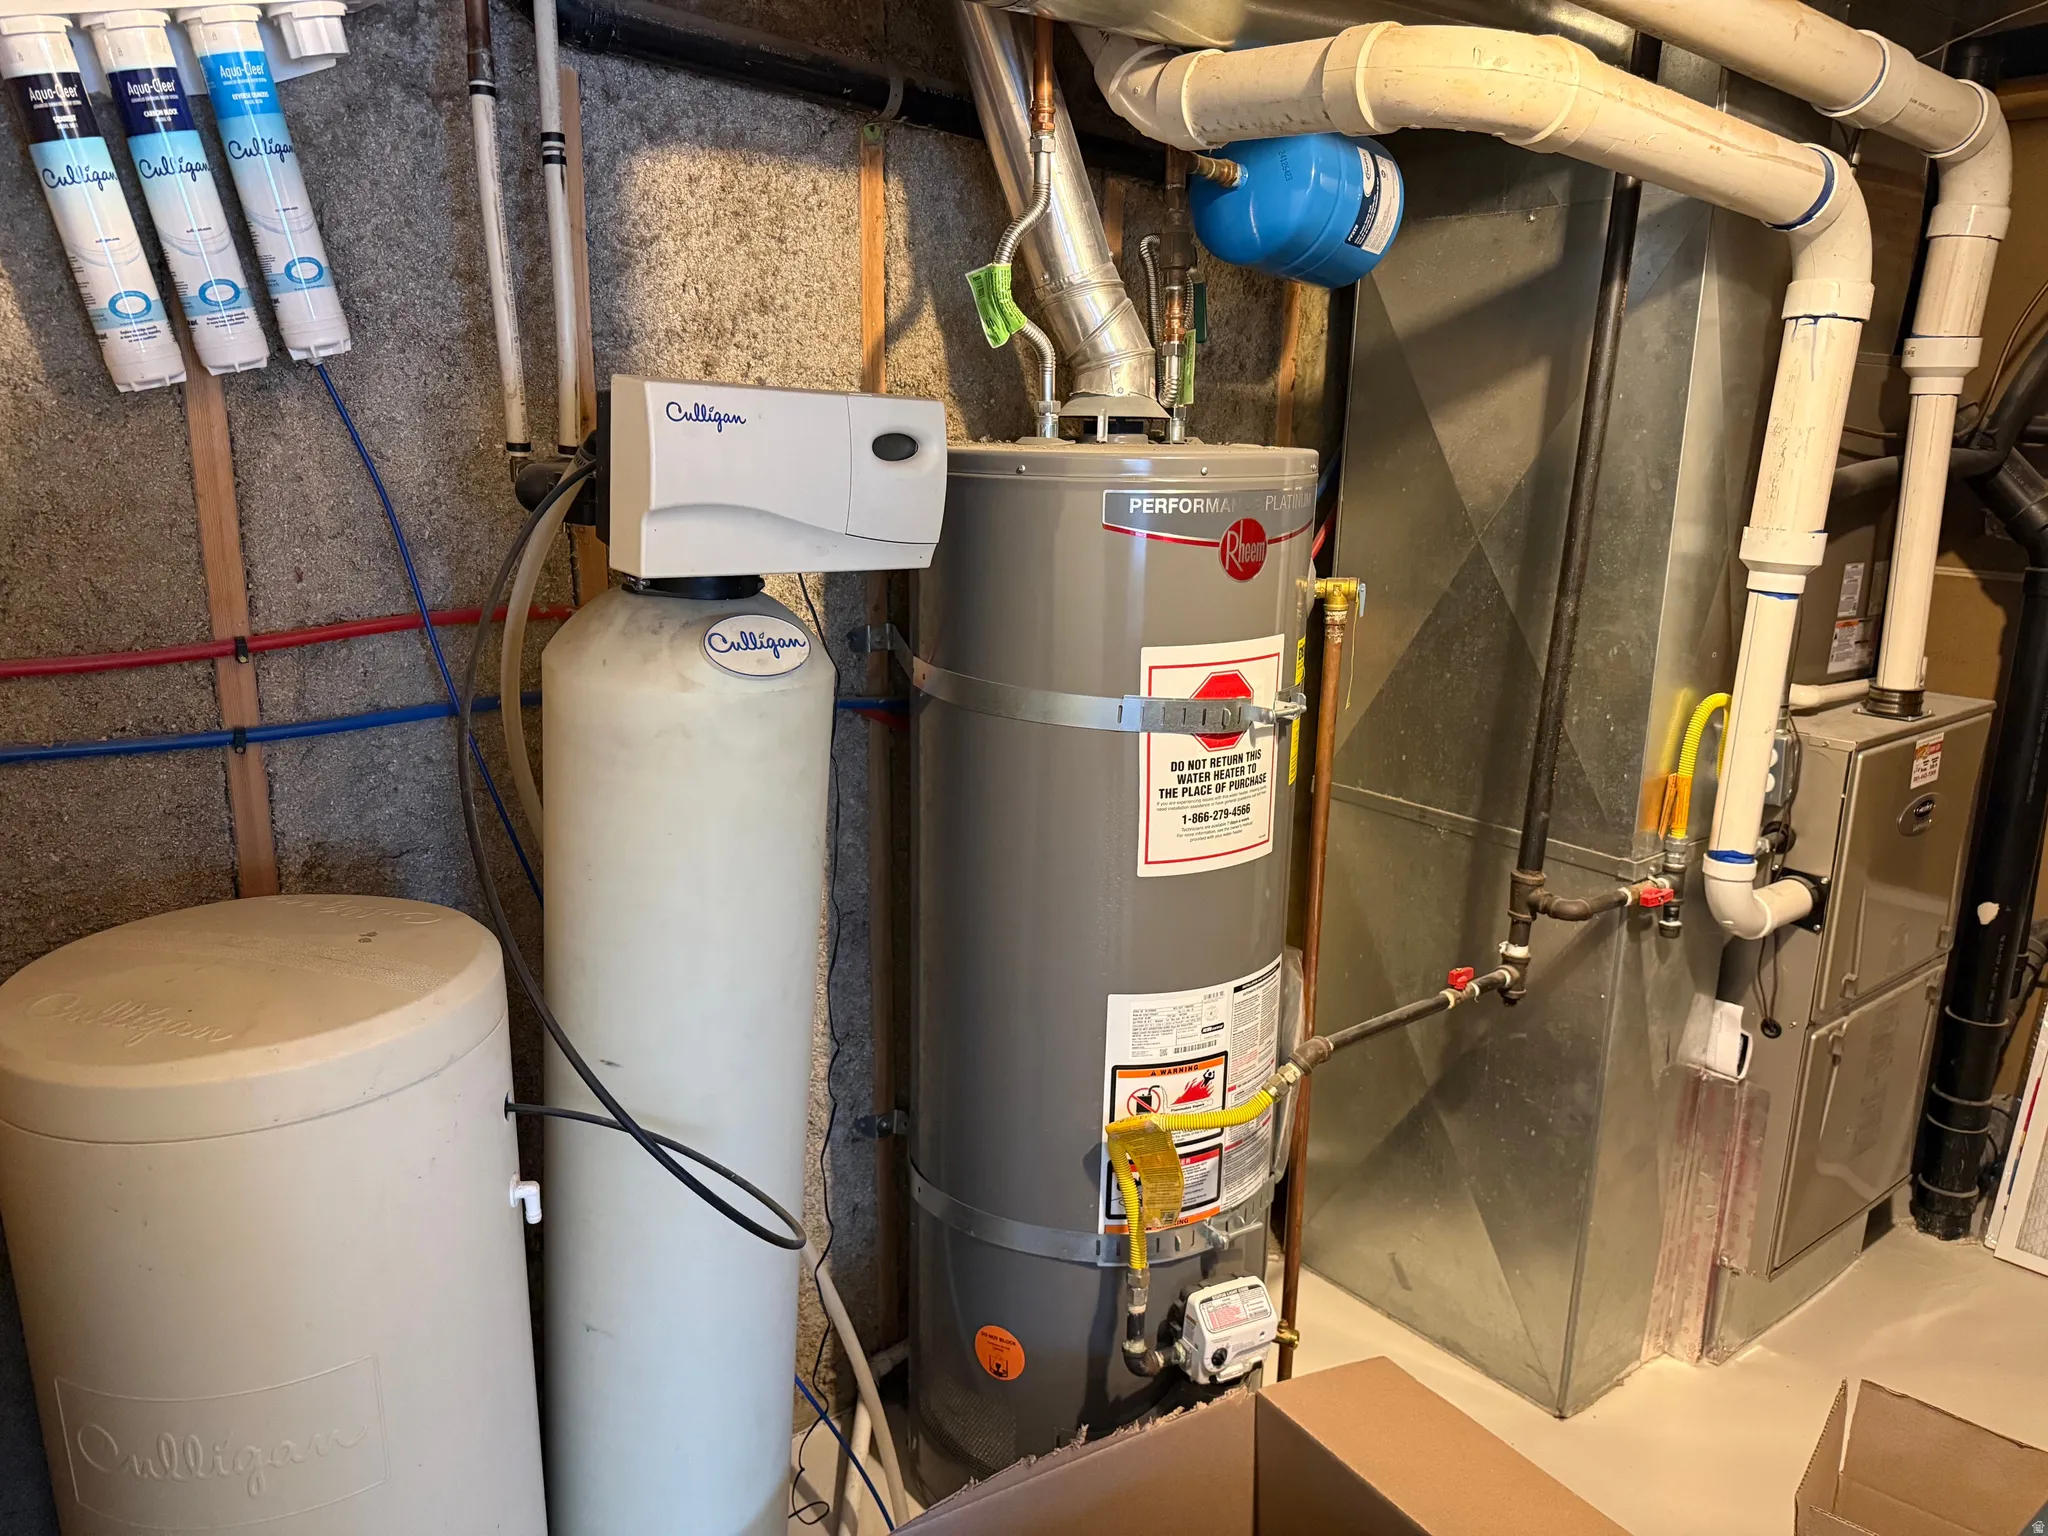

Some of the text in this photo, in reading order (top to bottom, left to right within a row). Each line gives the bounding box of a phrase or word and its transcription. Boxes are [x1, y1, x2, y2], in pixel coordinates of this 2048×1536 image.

[220, 62, 264, 80] Aqua-Cleer
[29, 83, 78, 103] Aqua-Cleer
[127, 78, 175, 96] Aqua-Cleer
[42, 165, 117, 191] Culligan
[666, 401, 747, 432] Culligan
[1129, 493, 1313, 514] PERFORMAN PLATINUM
[1225, 519, 1265, 572] Rheem
[708, 632, 807, 660] Culligan
[1171, 749, 1261, 772] DO NOT RETURN THIS
[1177, 763, 1256, 785] WATER HEATER TO
[1159, 773, 1267, 799] THE PLACE OF PURCHASE
[1182, 804, 1251, 824] 1-866-279-4566
[24, 993, 233, 1047] Culligan
[1160, 1065, 1198, 1075] WARNING
[77, 1422, 368, 1499] Culligan
